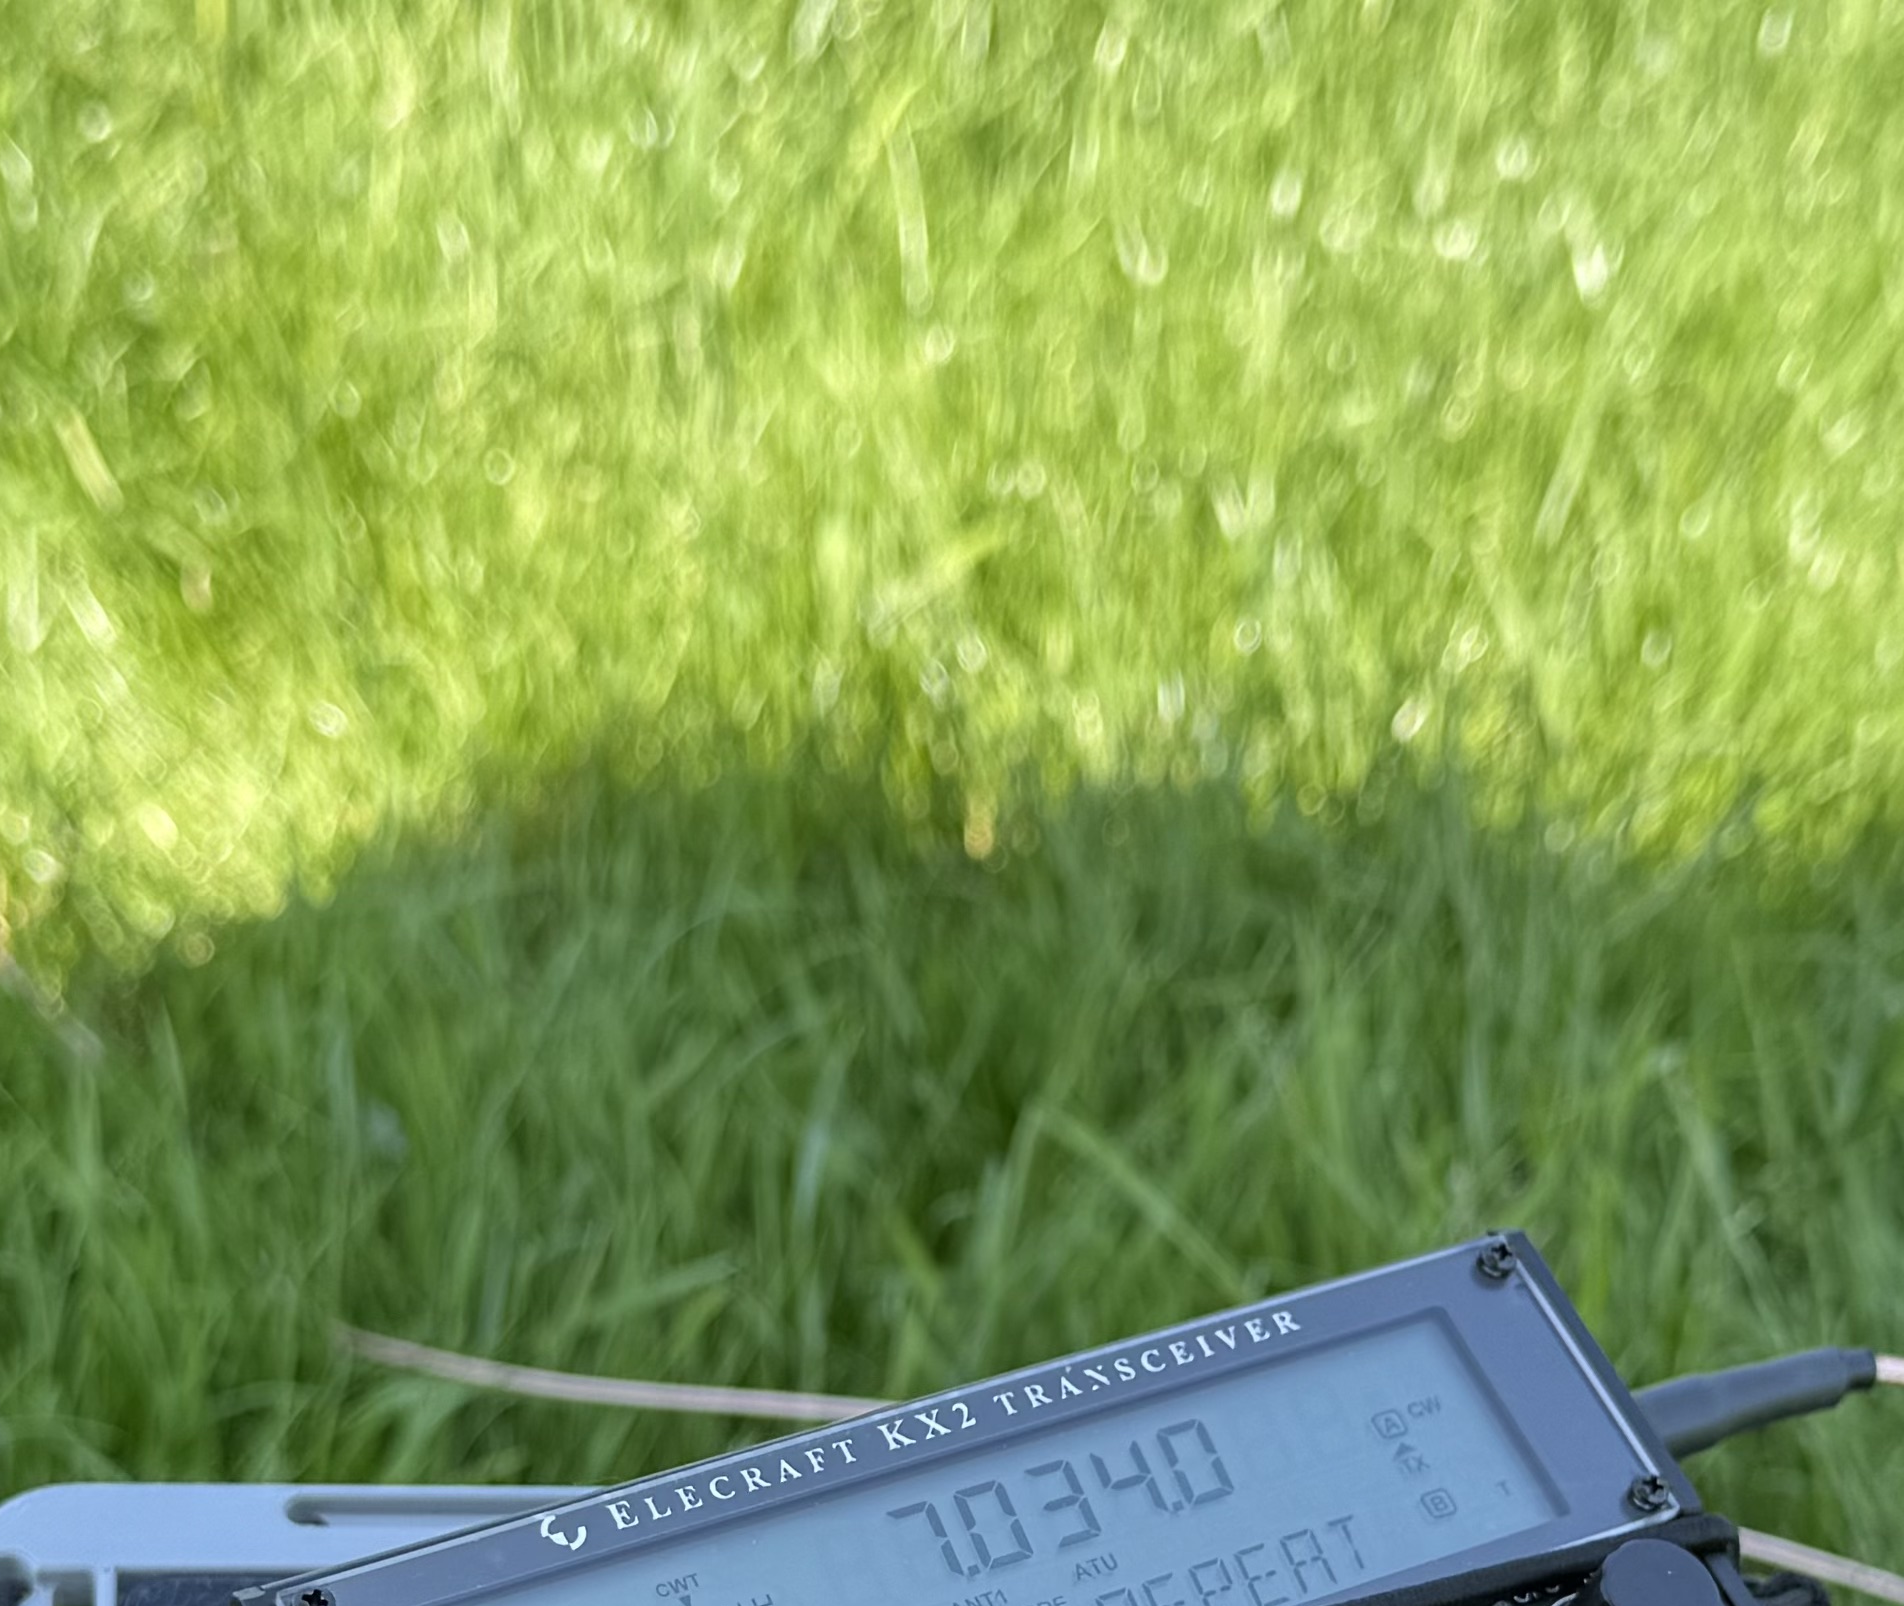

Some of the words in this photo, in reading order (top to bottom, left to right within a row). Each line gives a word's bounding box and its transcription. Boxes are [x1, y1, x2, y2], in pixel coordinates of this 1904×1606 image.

[606, 1439, 857, 1529] ELECRAFT
[877, 1402, 976, 1450] KX2
[994, 1310, 1301, 1416] TRANSCEIVER
[1407, 1395, 1441, 1418] CW
[1401, 1454, 1430, 1473] TX
[1074, 1553, 1119, 1582] ATU
[655, 1573, 701, 1599] CWT
